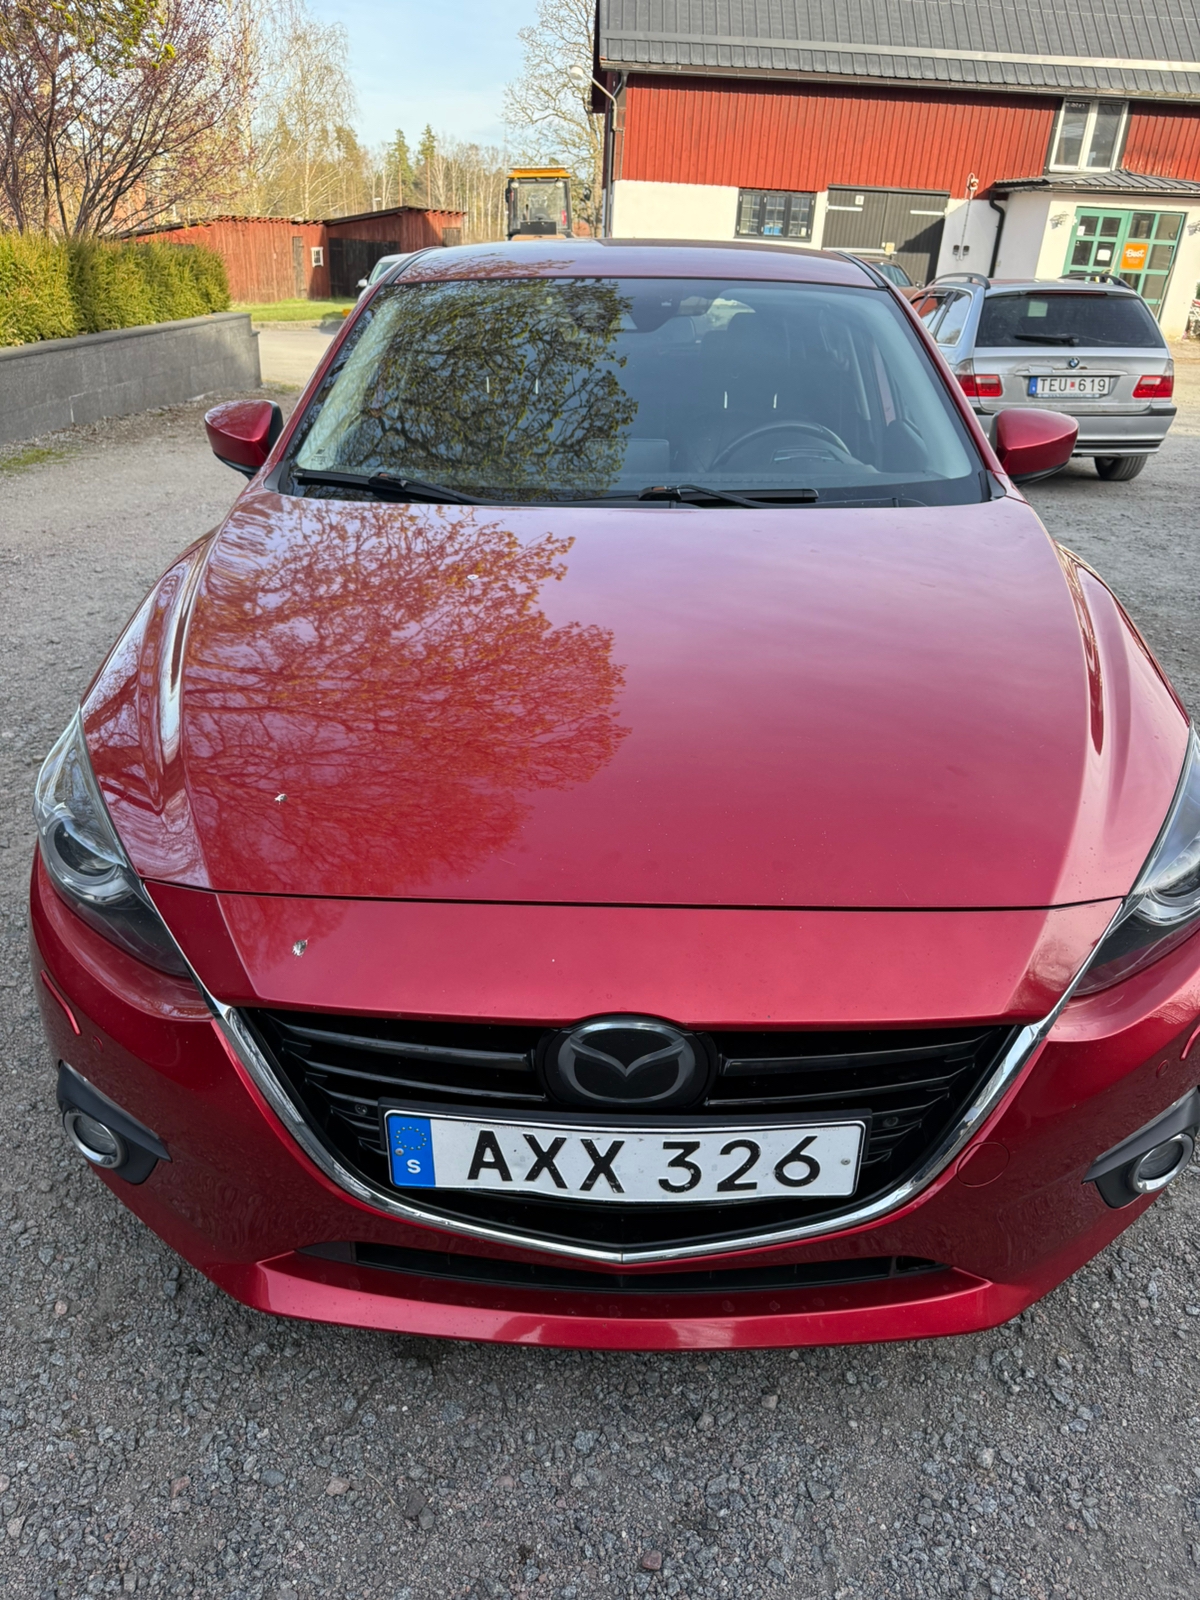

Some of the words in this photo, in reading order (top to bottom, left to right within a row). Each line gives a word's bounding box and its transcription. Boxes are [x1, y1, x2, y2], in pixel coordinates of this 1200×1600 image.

[1040, 378, 1068, 392] TEU
[1078, 378, 1106, 392] 619
[406, 1159, 421, 1174] S
[467, 1130, 625, 1193] AXX
[658, 1135, 821, 1194] 326
